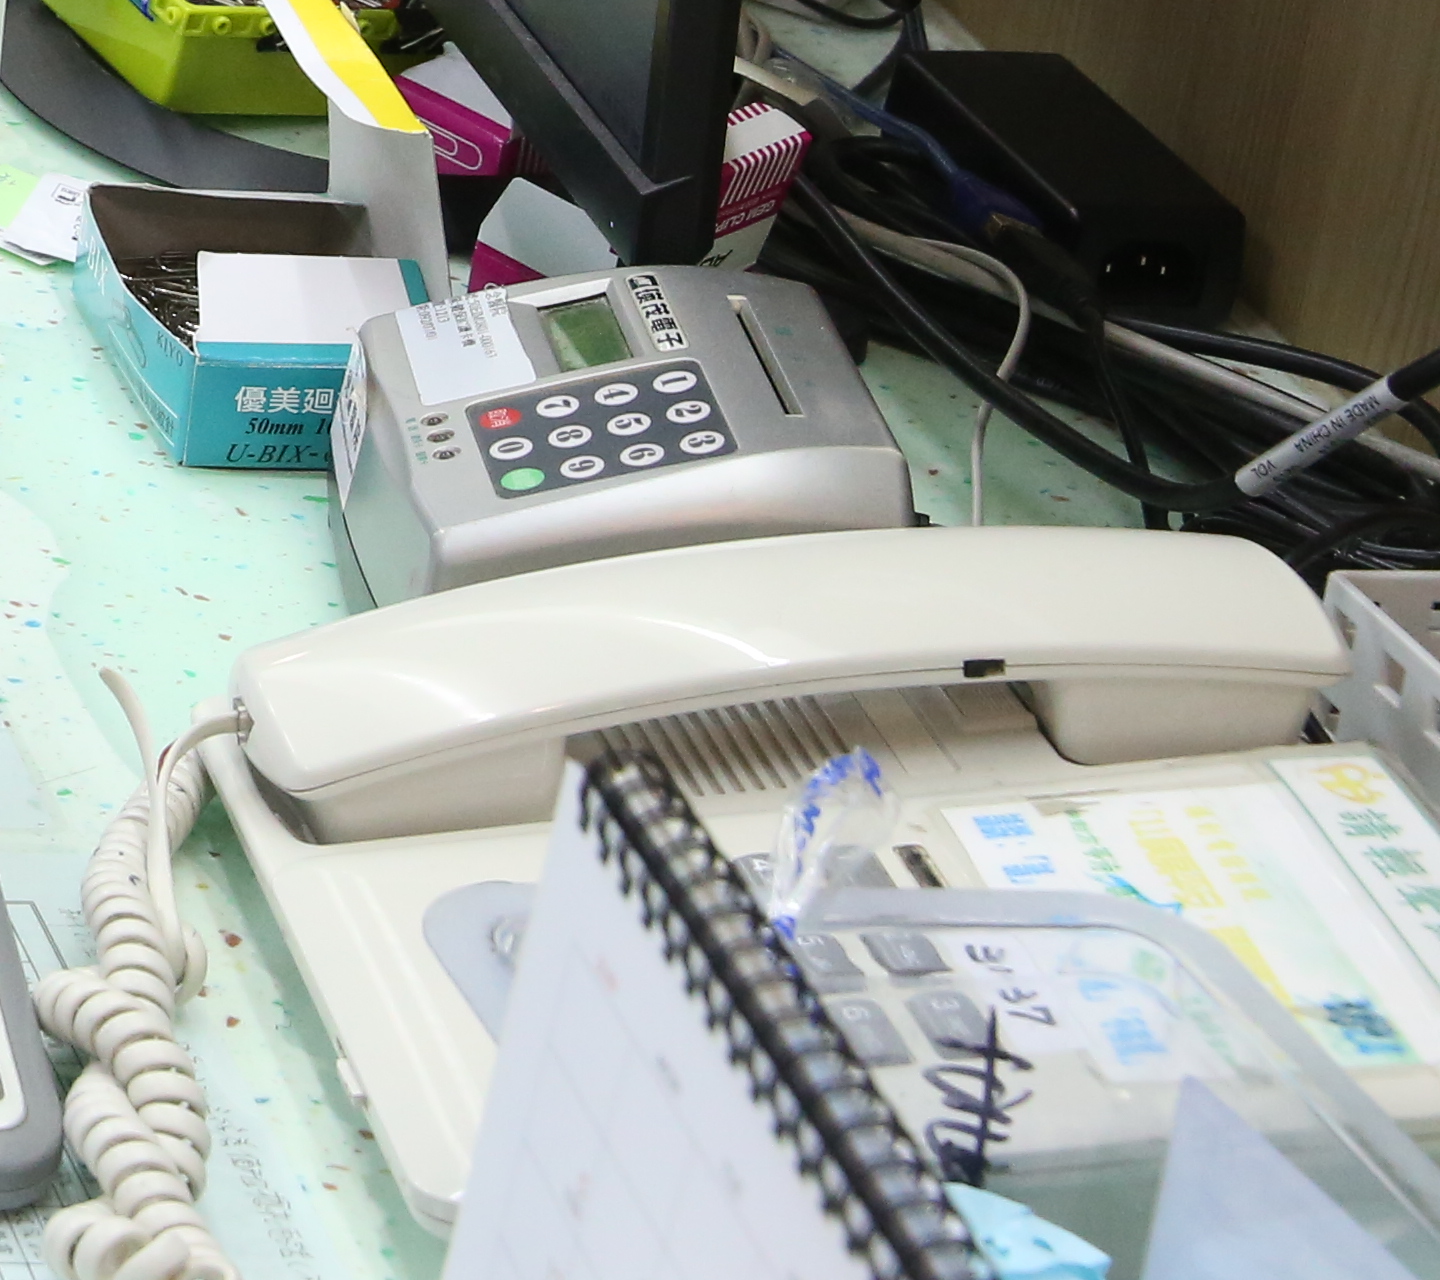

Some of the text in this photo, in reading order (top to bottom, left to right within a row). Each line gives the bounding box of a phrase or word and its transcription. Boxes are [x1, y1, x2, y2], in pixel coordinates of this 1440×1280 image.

[746, 200, 776, 221] GEM
[156, 330, 184, 367] KIYO
[661, 374, 688, 387] 1
[234, 386, 341, 414] 優美廻
[601, 388, 630, 402] 4
[544, 399, 573, 410] 7
[674, 405, 702, 419] 2
[244, 418, 303, 435] 50mm
[615, 417, 644, 430] 5
[555, 429, 584, 442] 8
[688, 434, 716, 450] 3
[497, 441, 525, 455] 0
[629, 447, 657, 461] 6
[569, 461, 597, 473] 9
